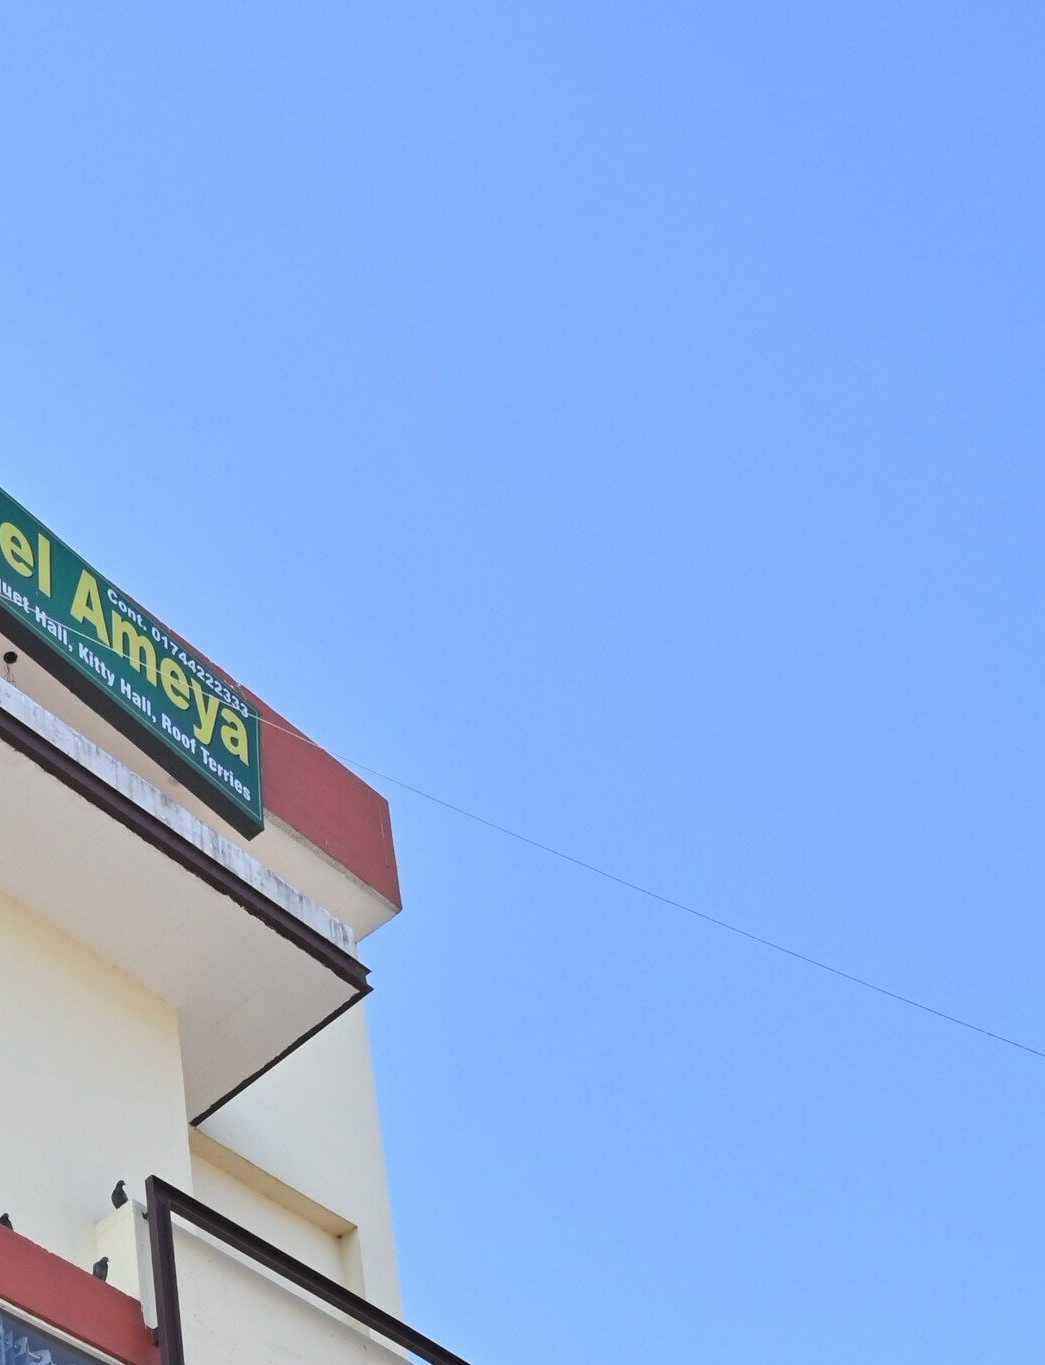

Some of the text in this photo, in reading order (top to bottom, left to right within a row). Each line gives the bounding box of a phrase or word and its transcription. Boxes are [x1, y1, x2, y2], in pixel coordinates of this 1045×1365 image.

[35, 605, 73, 652] Hall,
[79, 643, 115, 687] Kitty
[120, 678, 157, 723] Hall,
[161, 713, 198, 754] Roof
[200, 747, 251, 801] Terries
[70, 569, 250, 767] Ameya
[107, 588, 249, 718] Cont. 01744222333
